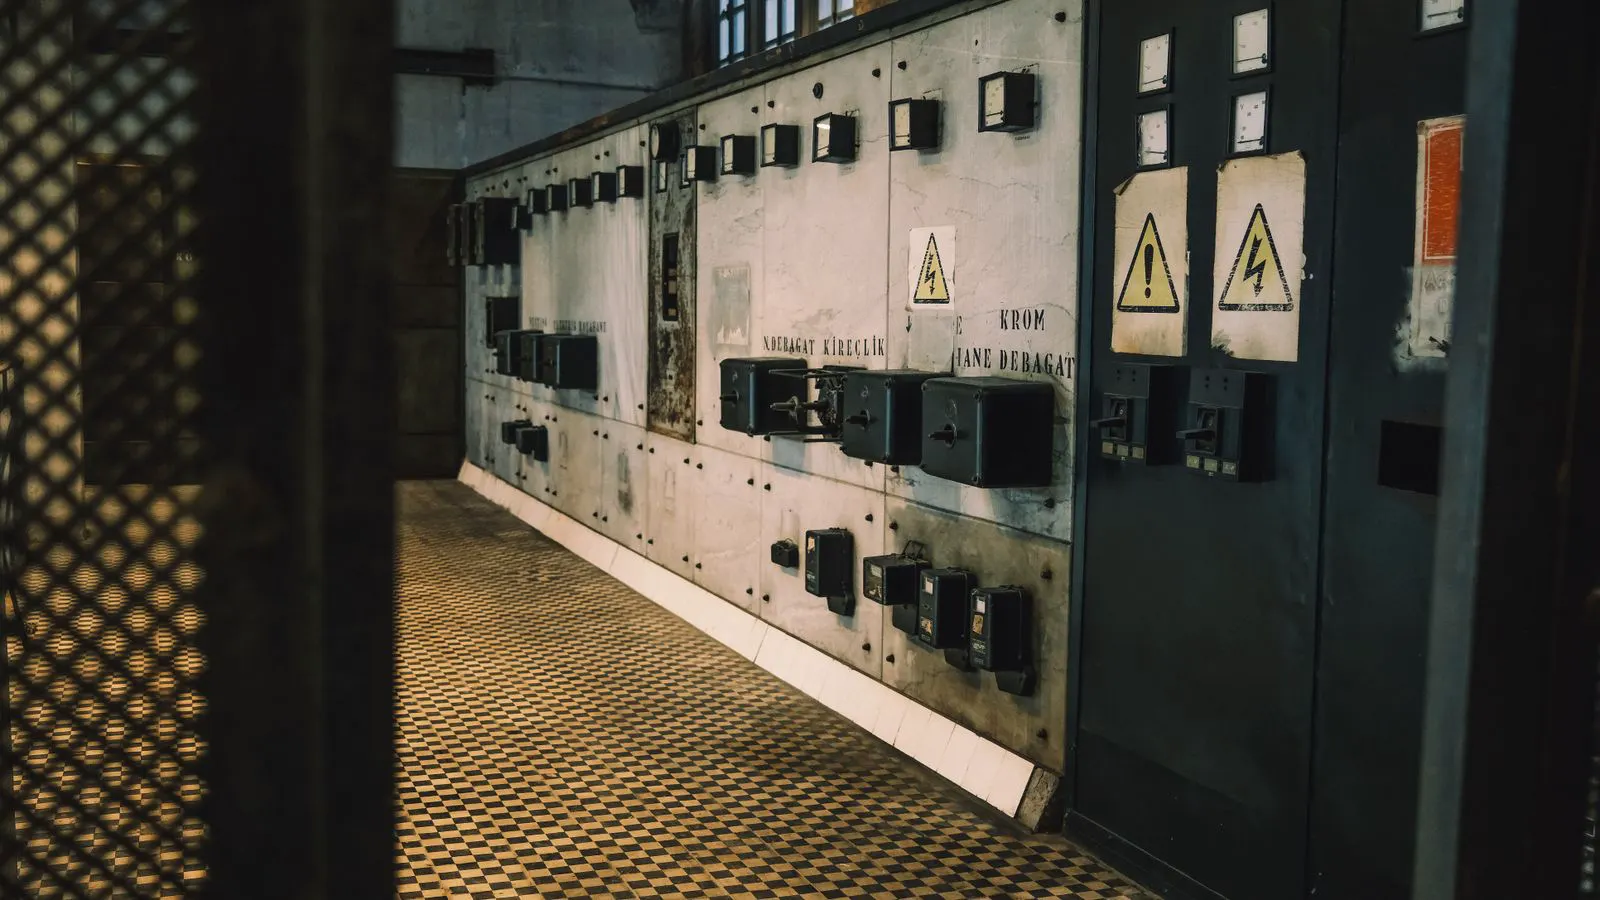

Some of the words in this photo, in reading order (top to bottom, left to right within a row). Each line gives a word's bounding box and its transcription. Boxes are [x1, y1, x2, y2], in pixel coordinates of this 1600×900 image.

[1000, 308, 1045, 331] KROM
[824, 335, 885, 359] KİREÇLİK
[999, 349, 1075, 379] DEBAGAT
